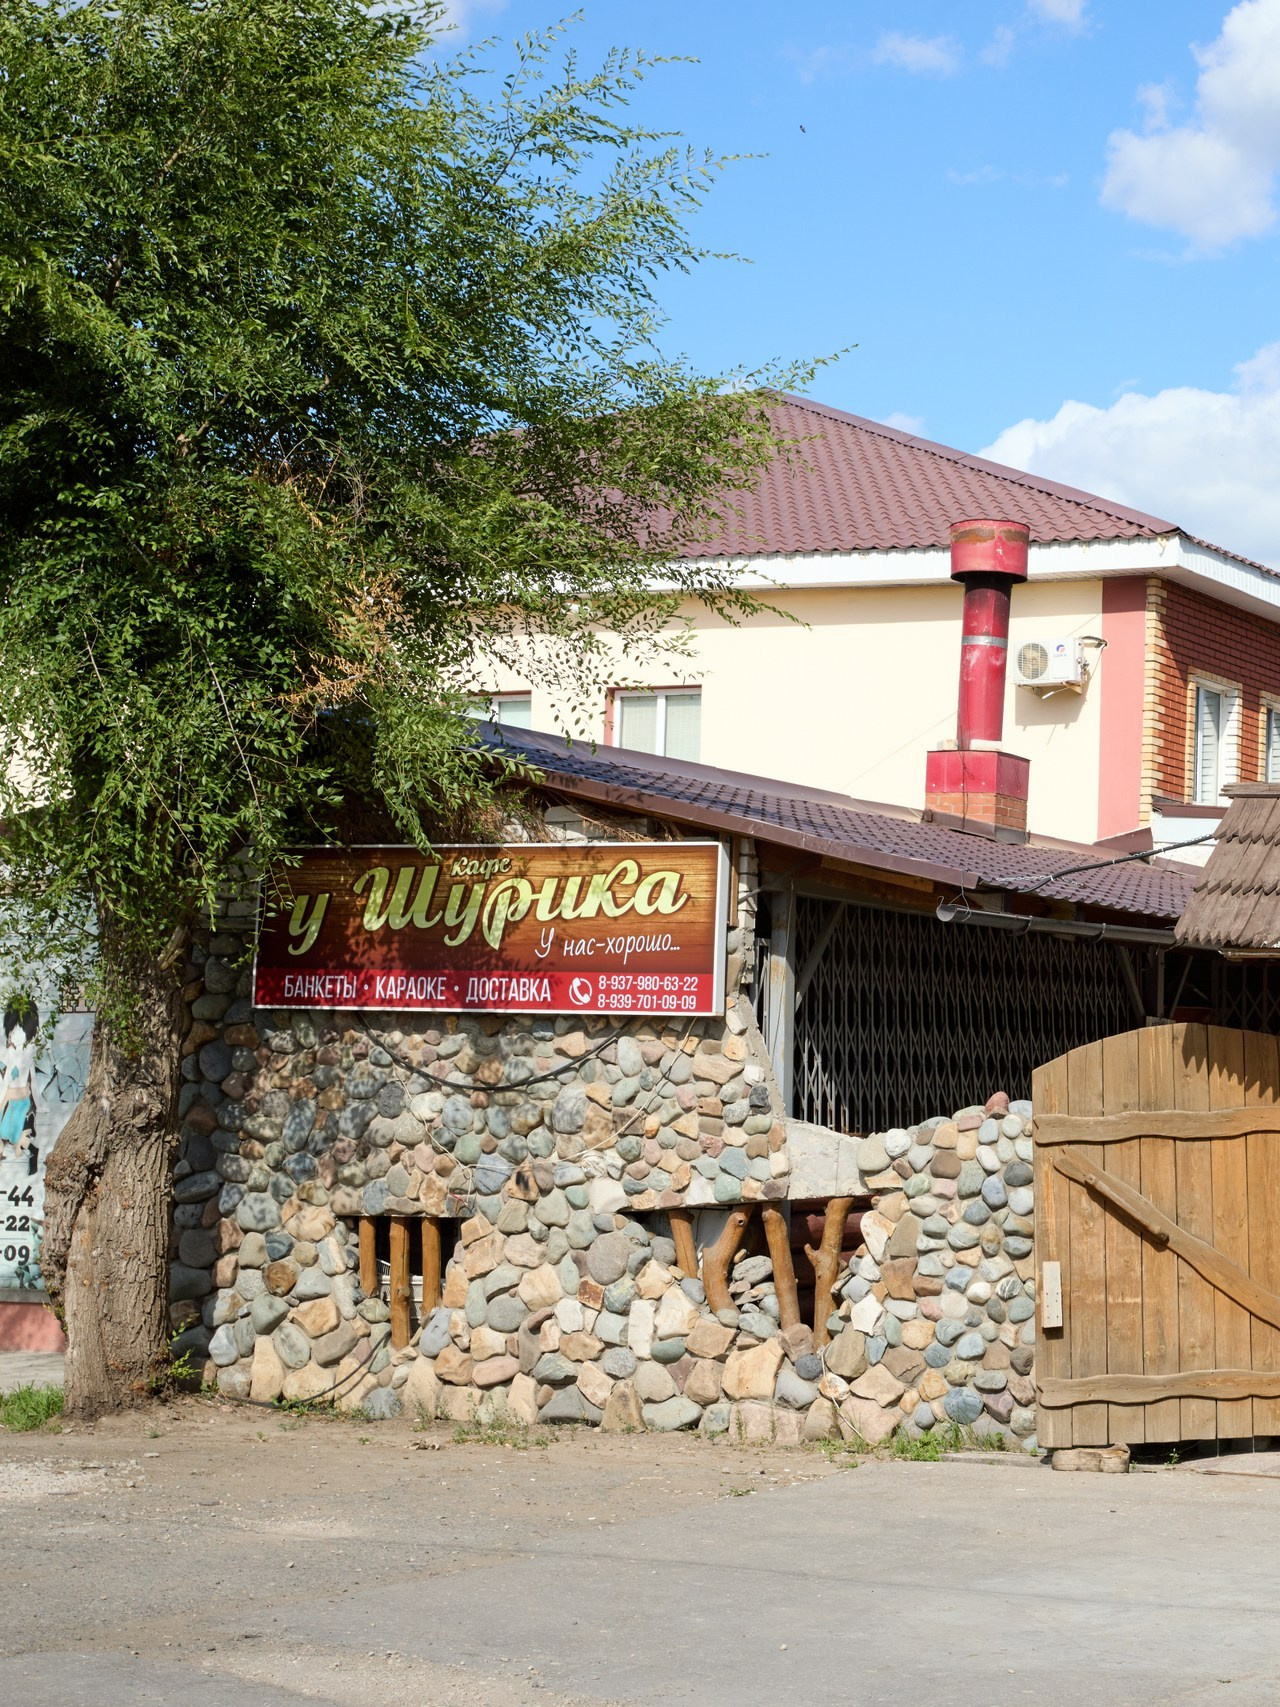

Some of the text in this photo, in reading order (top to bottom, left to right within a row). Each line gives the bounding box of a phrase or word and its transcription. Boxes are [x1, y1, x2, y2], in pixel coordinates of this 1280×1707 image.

[353, 859, 688, 951] Шурика
[284, 975, 552, 1003] БАНКЕТЫ КАРАОКЕ ДОСТАВКА
[598, 975, 699, 991] 8-937-980-63-22
[597, 993, 697, 1010] 8-939-701-09-09
[0, 1245, 30, 1266] 09
